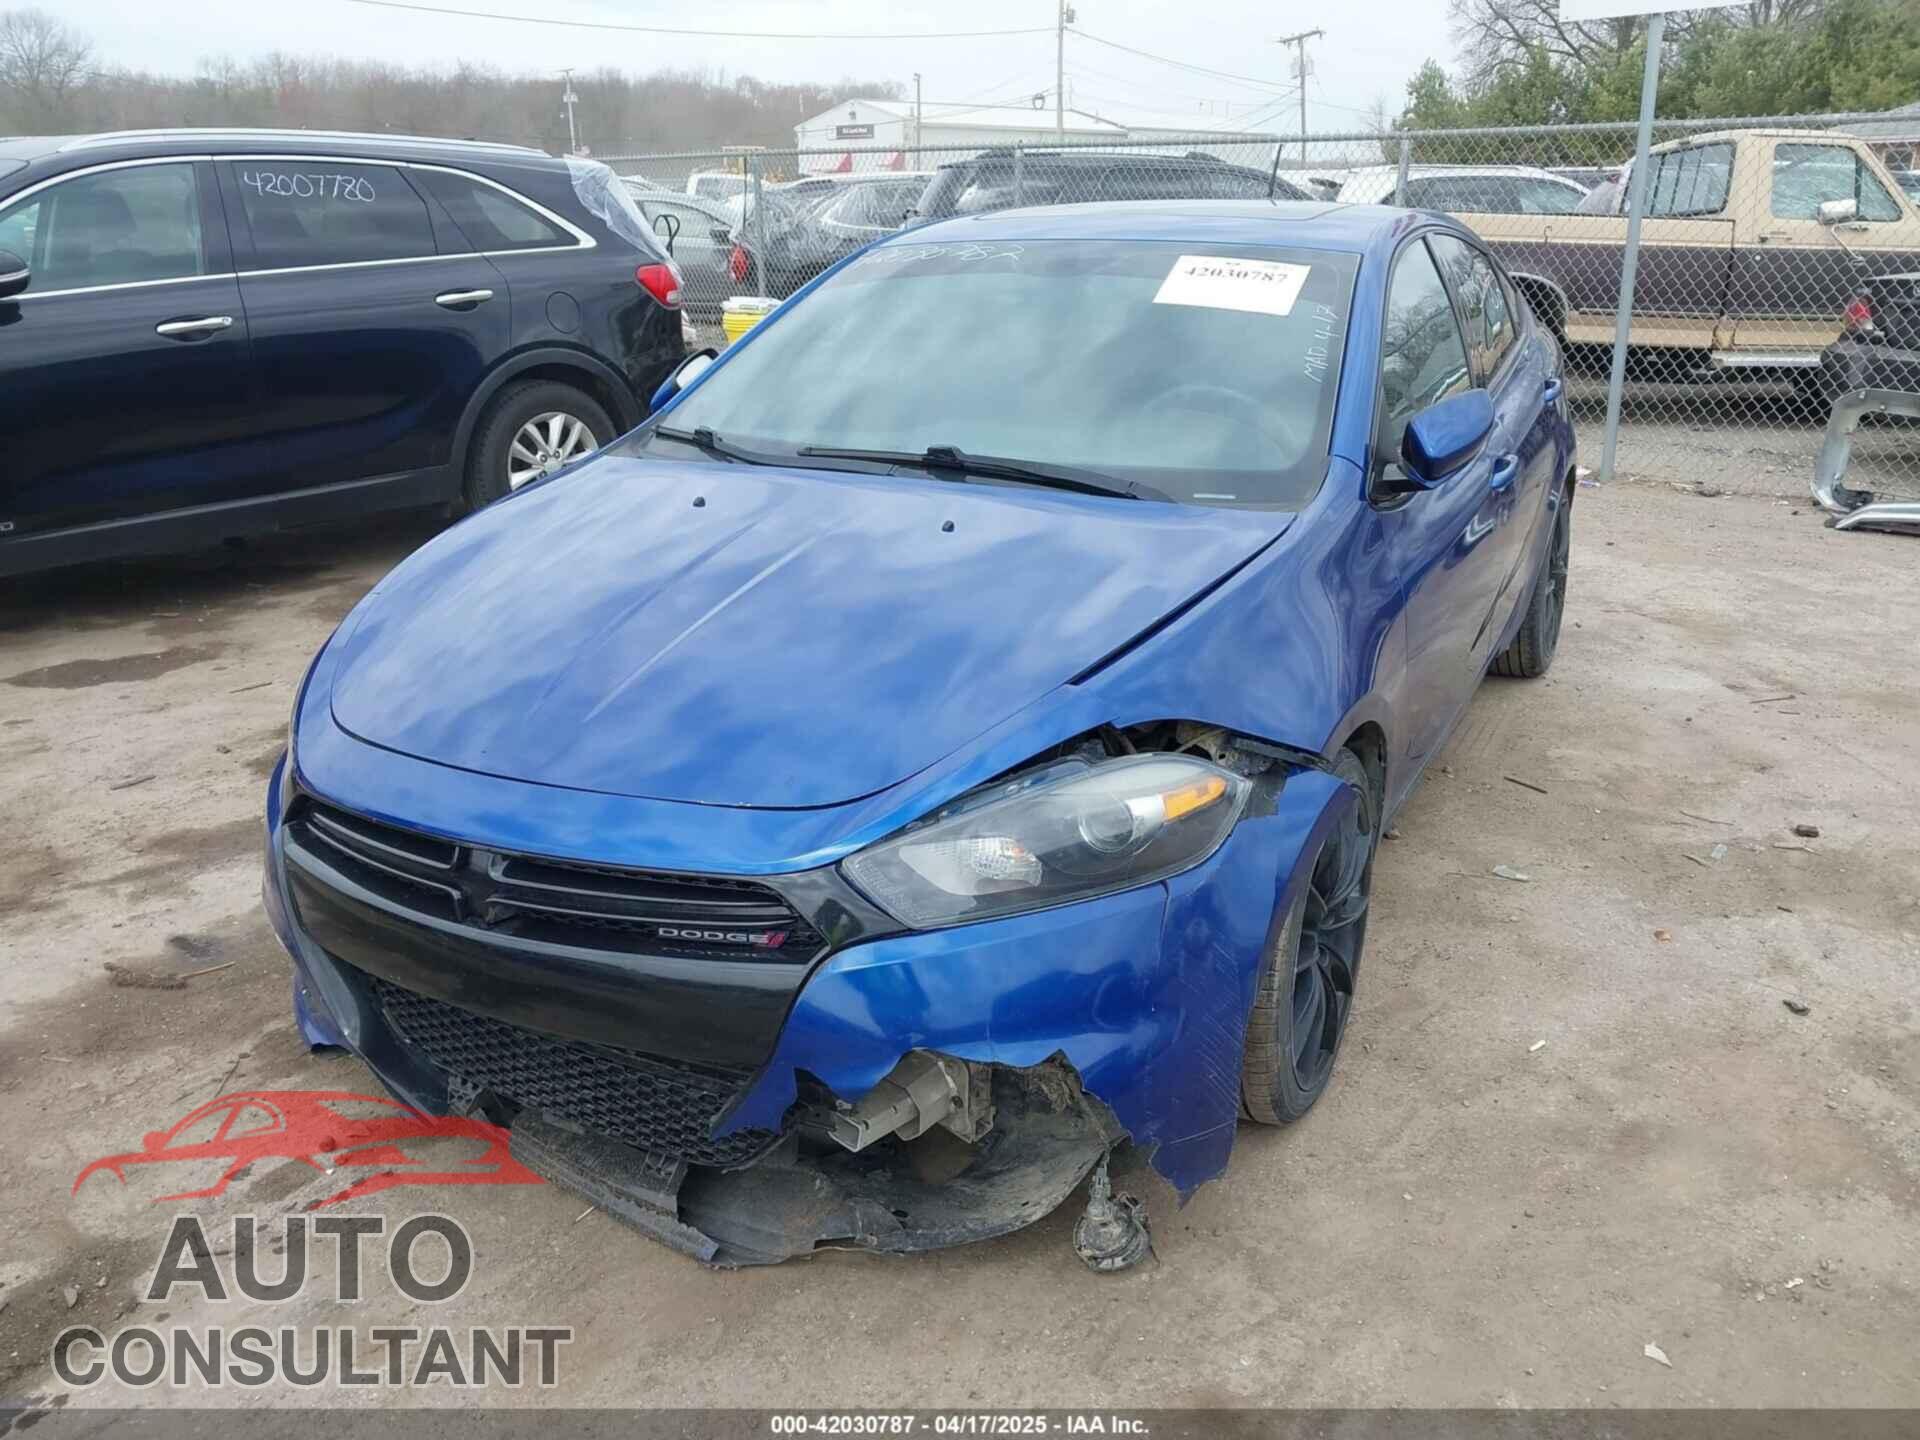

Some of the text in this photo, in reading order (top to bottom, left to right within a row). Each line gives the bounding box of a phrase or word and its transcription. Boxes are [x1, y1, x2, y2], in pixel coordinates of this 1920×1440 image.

[243, 171, 376, 202] 42007780
[1184, 265, 1288, 283] 42030787
[658, 927, 769, 944] DODGE
